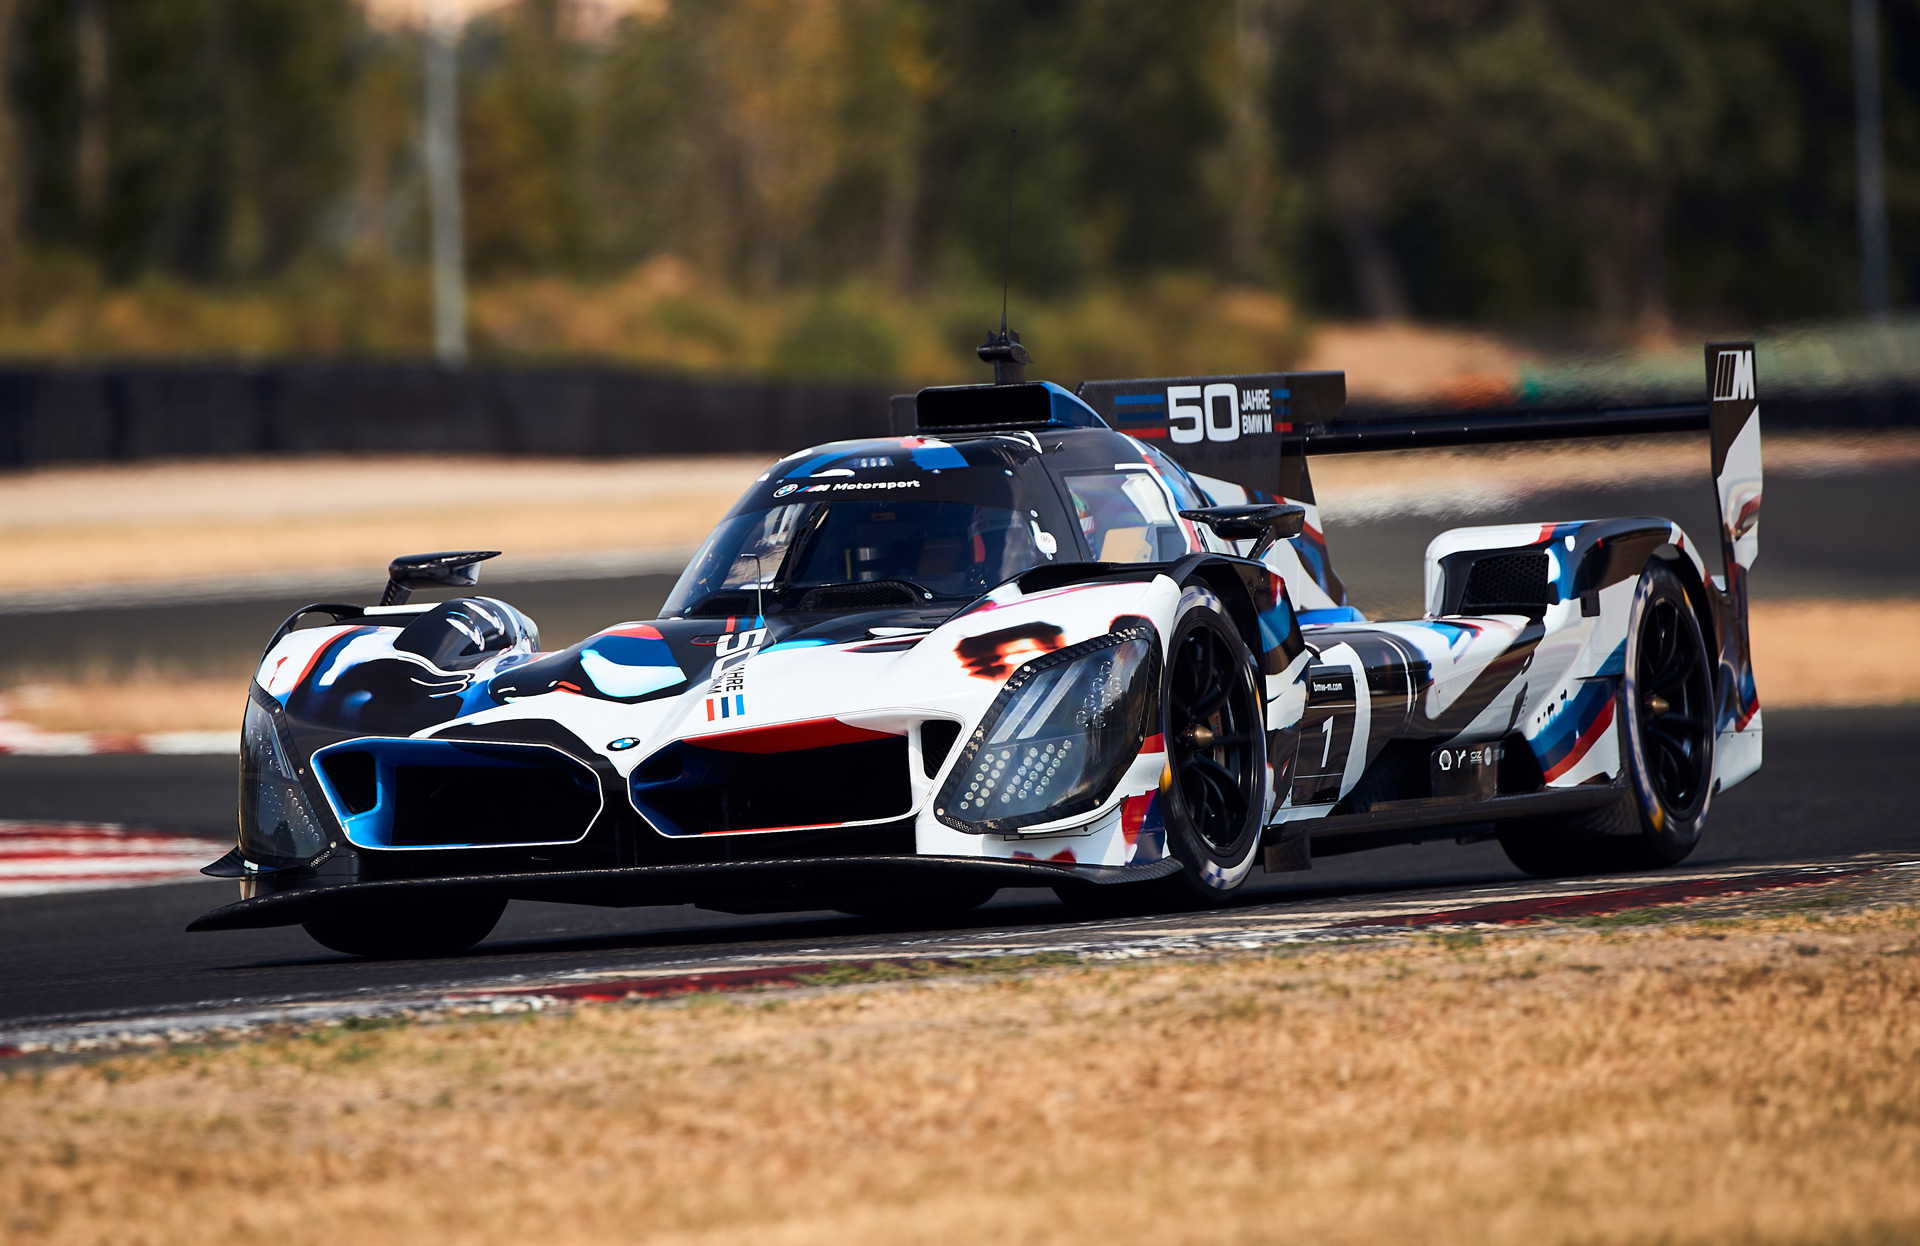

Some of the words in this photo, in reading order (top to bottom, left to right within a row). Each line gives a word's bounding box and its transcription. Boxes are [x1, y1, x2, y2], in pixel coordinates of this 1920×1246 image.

[1241, 389, 1271, 411] JAHRE
[1167, 383, 1241, 444] 50
[1241, 414, 1264, 434] BMW
[1265, 413, 1273, 433] M
[832, 480, 920, 491] Motorsport
[711, 627, 768, 680] 50
[1312, 681, 1343, 692] bmw-m.com
[1321, 715, 1334, 769] 1
